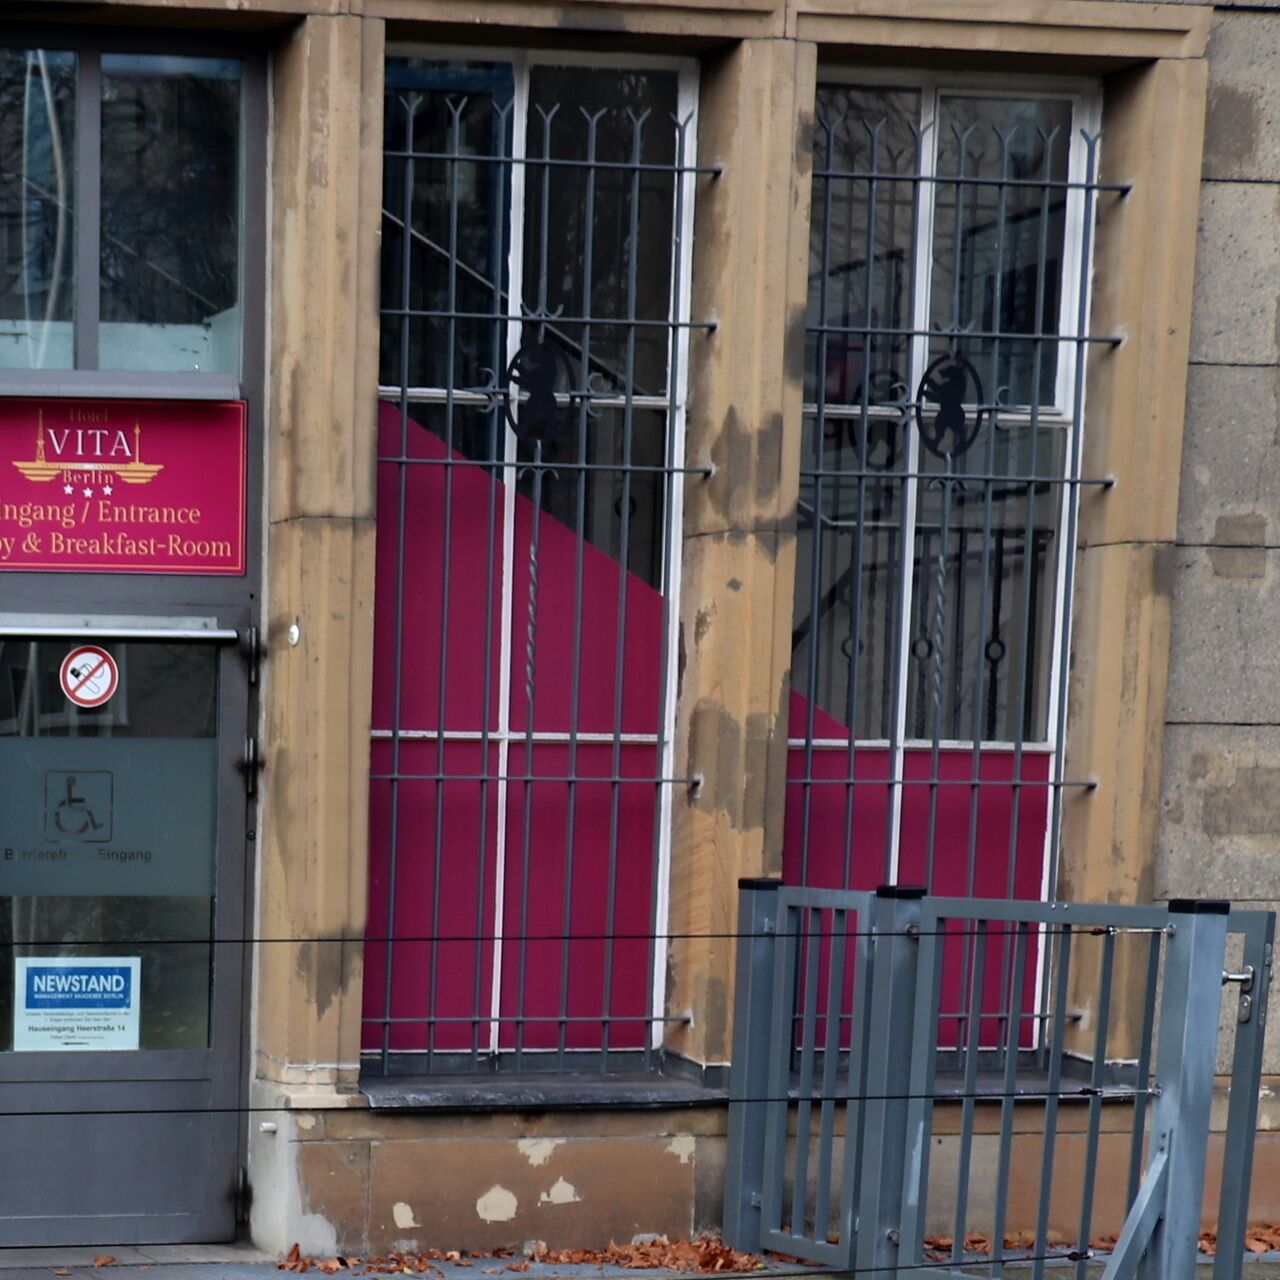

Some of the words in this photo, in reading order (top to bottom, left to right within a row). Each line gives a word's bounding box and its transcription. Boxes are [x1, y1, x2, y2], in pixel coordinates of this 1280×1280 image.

[69, 408, 109, 422] Hotel
[47, 428, 132, 457] VITA
[63, 470, 114, 484] Berlin
[81, 501, 90, 524] /
[98, 500, 201, 524] Entrance
[22, 532, 42, 553] &
[50, 532, 232, 557] Breakfast-Room
[33, 975, 125, 993] NEWSTAND
